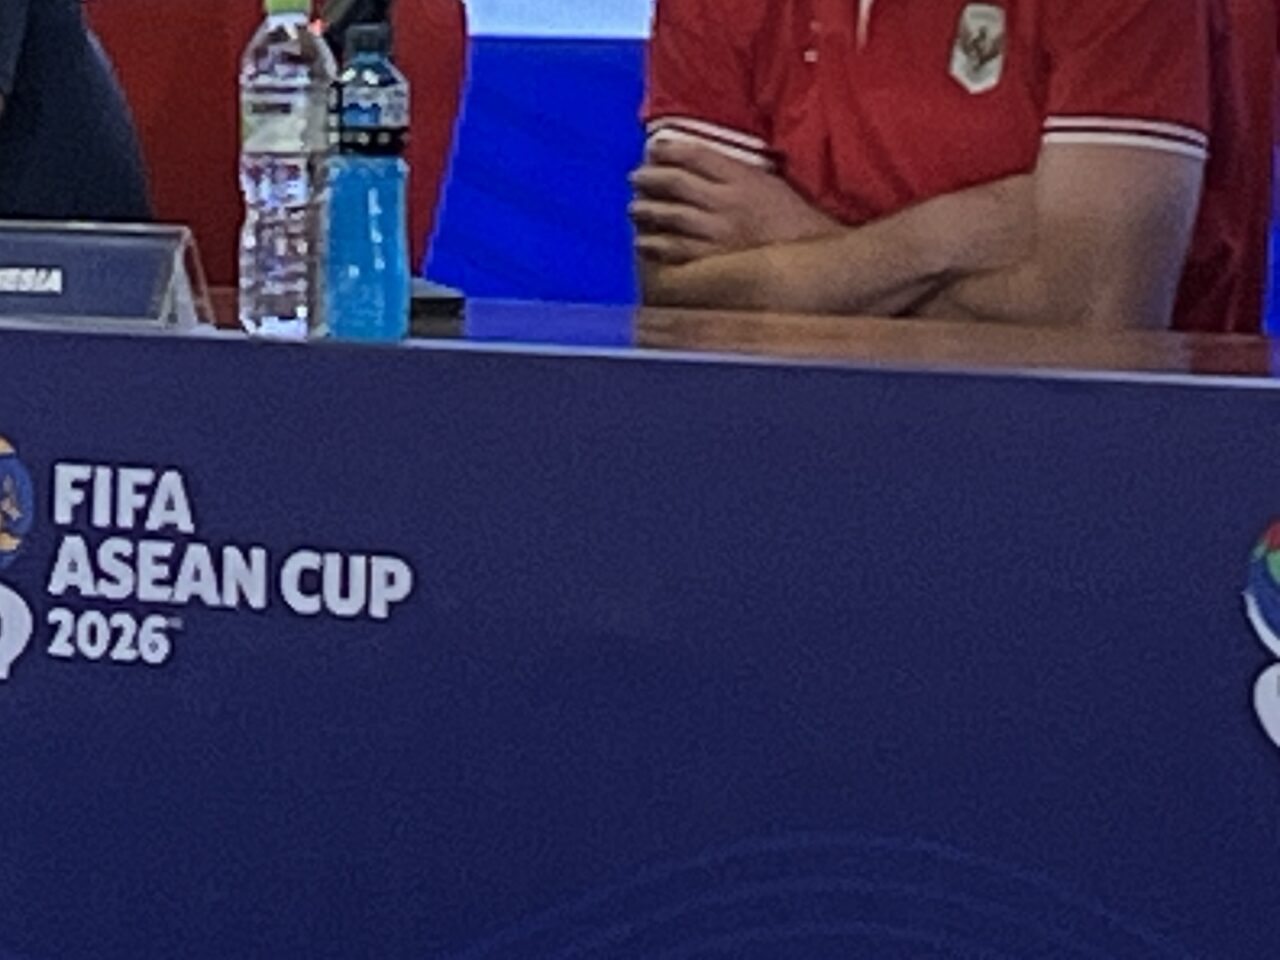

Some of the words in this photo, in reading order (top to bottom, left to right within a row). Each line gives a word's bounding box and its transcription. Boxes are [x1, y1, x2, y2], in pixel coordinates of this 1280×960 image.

[53, 462, 195, 534] FIFA
[47, 535, 267, 611] ASEAN
[279, 549, 413, 619] CUP
